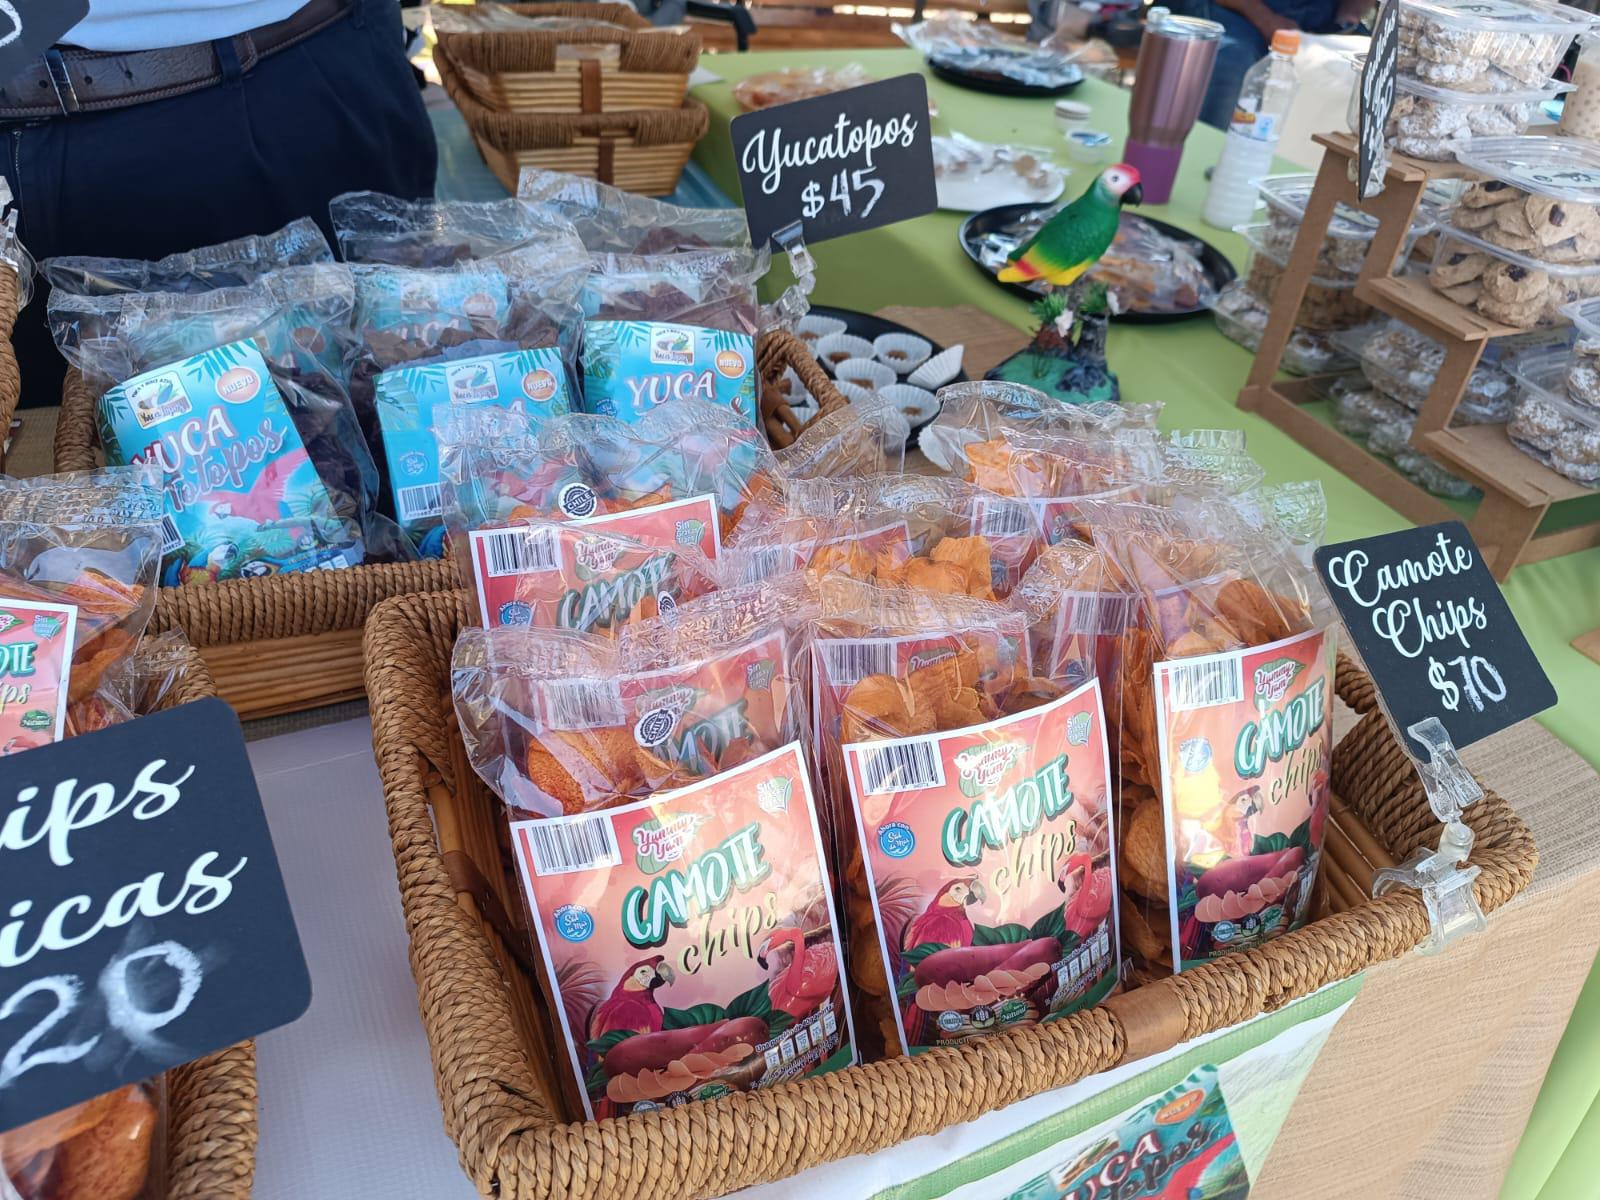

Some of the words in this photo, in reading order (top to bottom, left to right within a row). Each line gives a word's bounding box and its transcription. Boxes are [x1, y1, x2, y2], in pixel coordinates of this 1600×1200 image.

[742, 112, 918, 195] Yucatopos
[801, 166, 885, 219] $45
[222, 374, 257, 396] NUEVO
[625, 370, 717, 407] YUCA
[164, 417, 289, 513] Totopos
[566, 489, 595, 511] CHILE
[1328, 532, 1473, 608] Camote
[1372, 597, 1487, 658] Chips
[746, 662, 761, 674] Sin
[1257, 663, 1296, 690] Yummy
[1428, 656, 1507, 713] $70
[1235, 678, 1325, 778] CAMOTE
[1271, 738, 1324, 806] chips
[0, 759, 196, 867] ips
[635, 815, 697, 854] Yummy
[943, 754, 1074, 866] CAMOTE
[656, 835, 685, 861] Yam
[991, 819, 1077, 895] chips
[0, 851, 249, 968] icas
[623, 823, 769, 948] CAMOTE
[678, 892, 779, 976] chips
